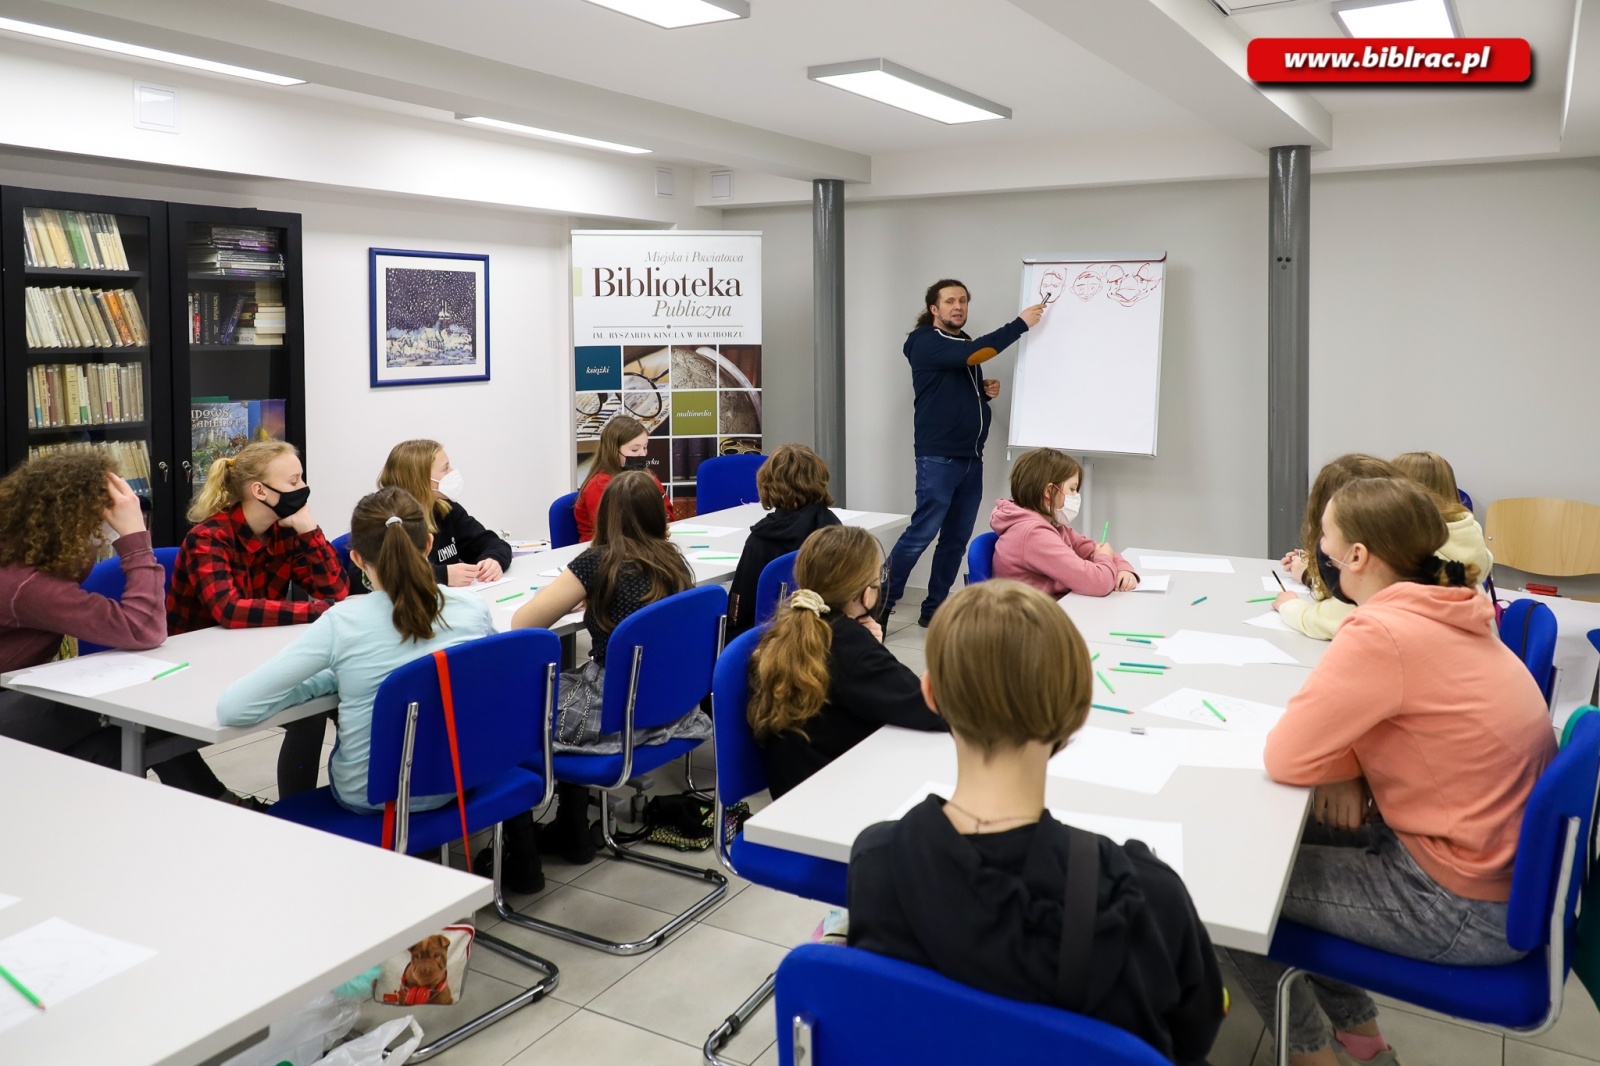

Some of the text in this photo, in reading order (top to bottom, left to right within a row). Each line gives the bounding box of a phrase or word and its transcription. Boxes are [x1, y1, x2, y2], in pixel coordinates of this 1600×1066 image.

[645, 251, 744, 265] Miejska i Powiatowa
[592, 266, 743, 297] Biblioteka
[652, 300, 732, 319] Publiczna
[585, 365, 610, 376] książki
[676, 409, 712, 418] multimedia
